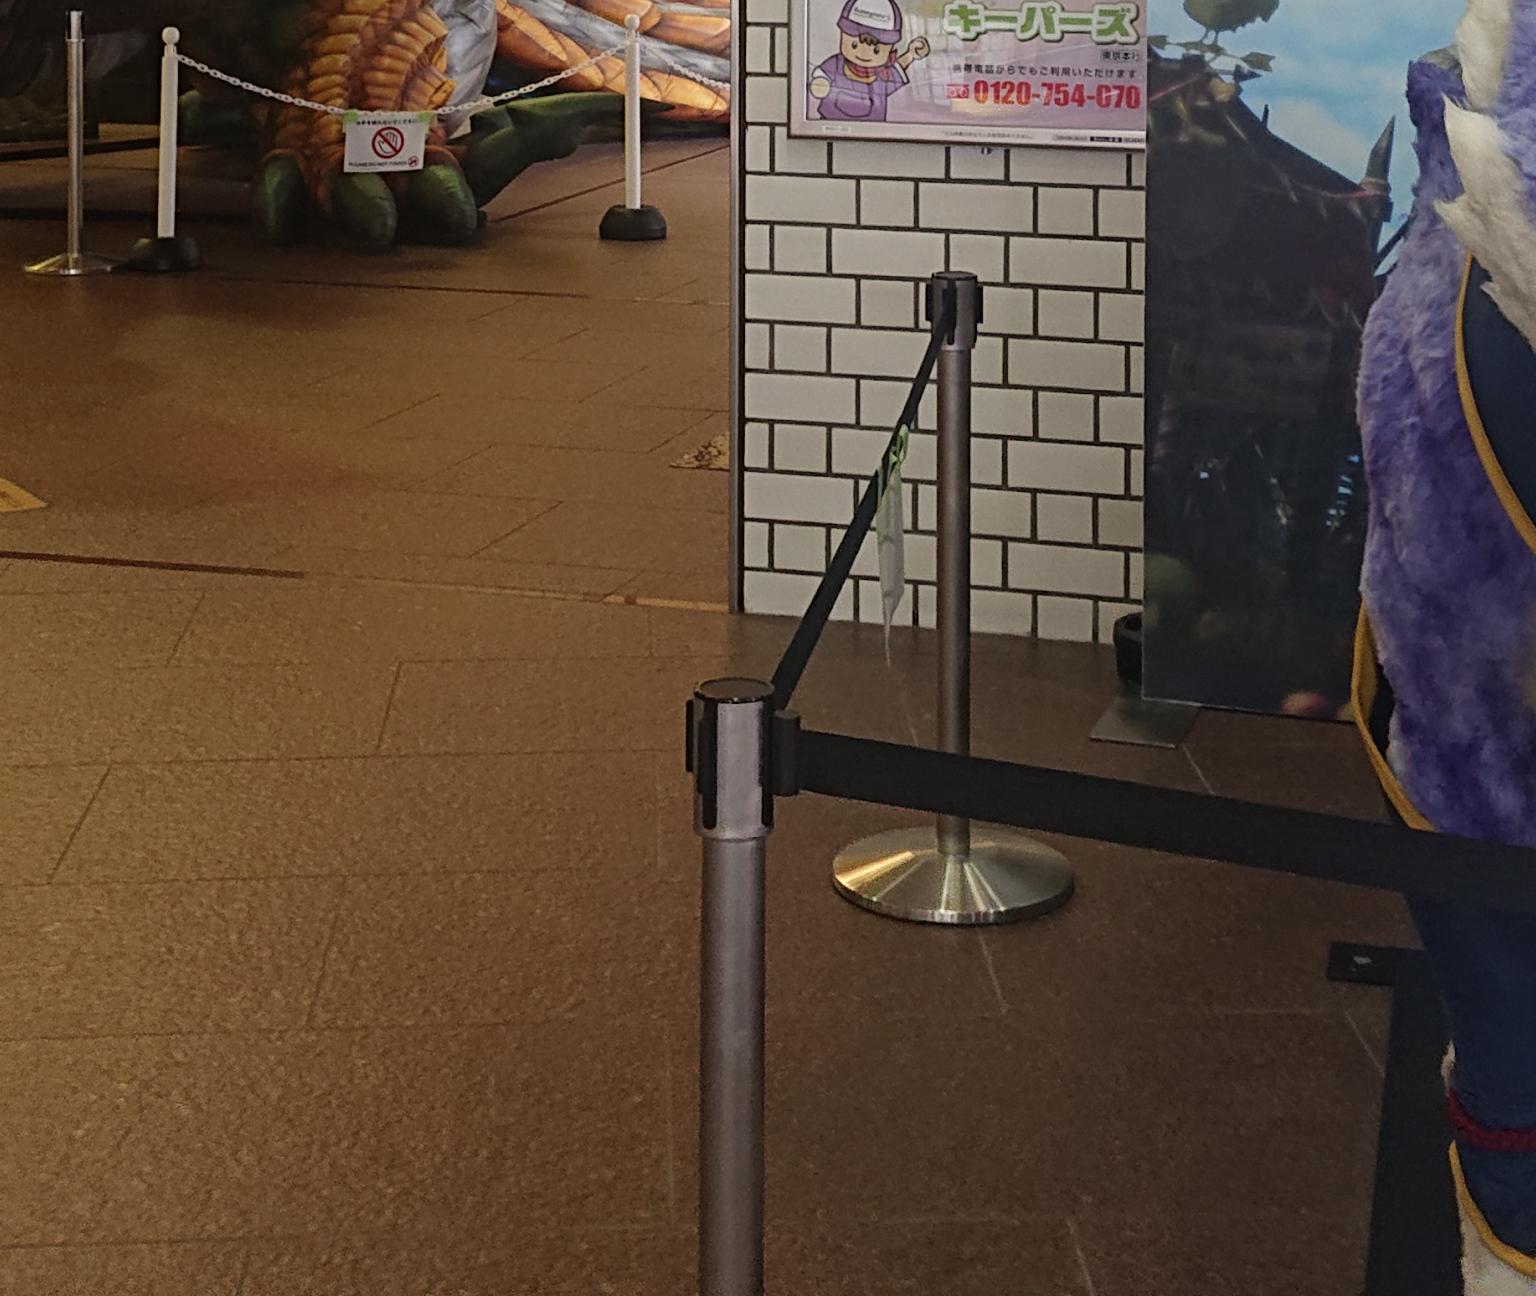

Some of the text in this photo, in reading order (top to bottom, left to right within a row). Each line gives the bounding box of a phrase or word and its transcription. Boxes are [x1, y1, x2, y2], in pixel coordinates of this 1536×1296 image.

[945, 1, 1137, 41] キーパーズ
